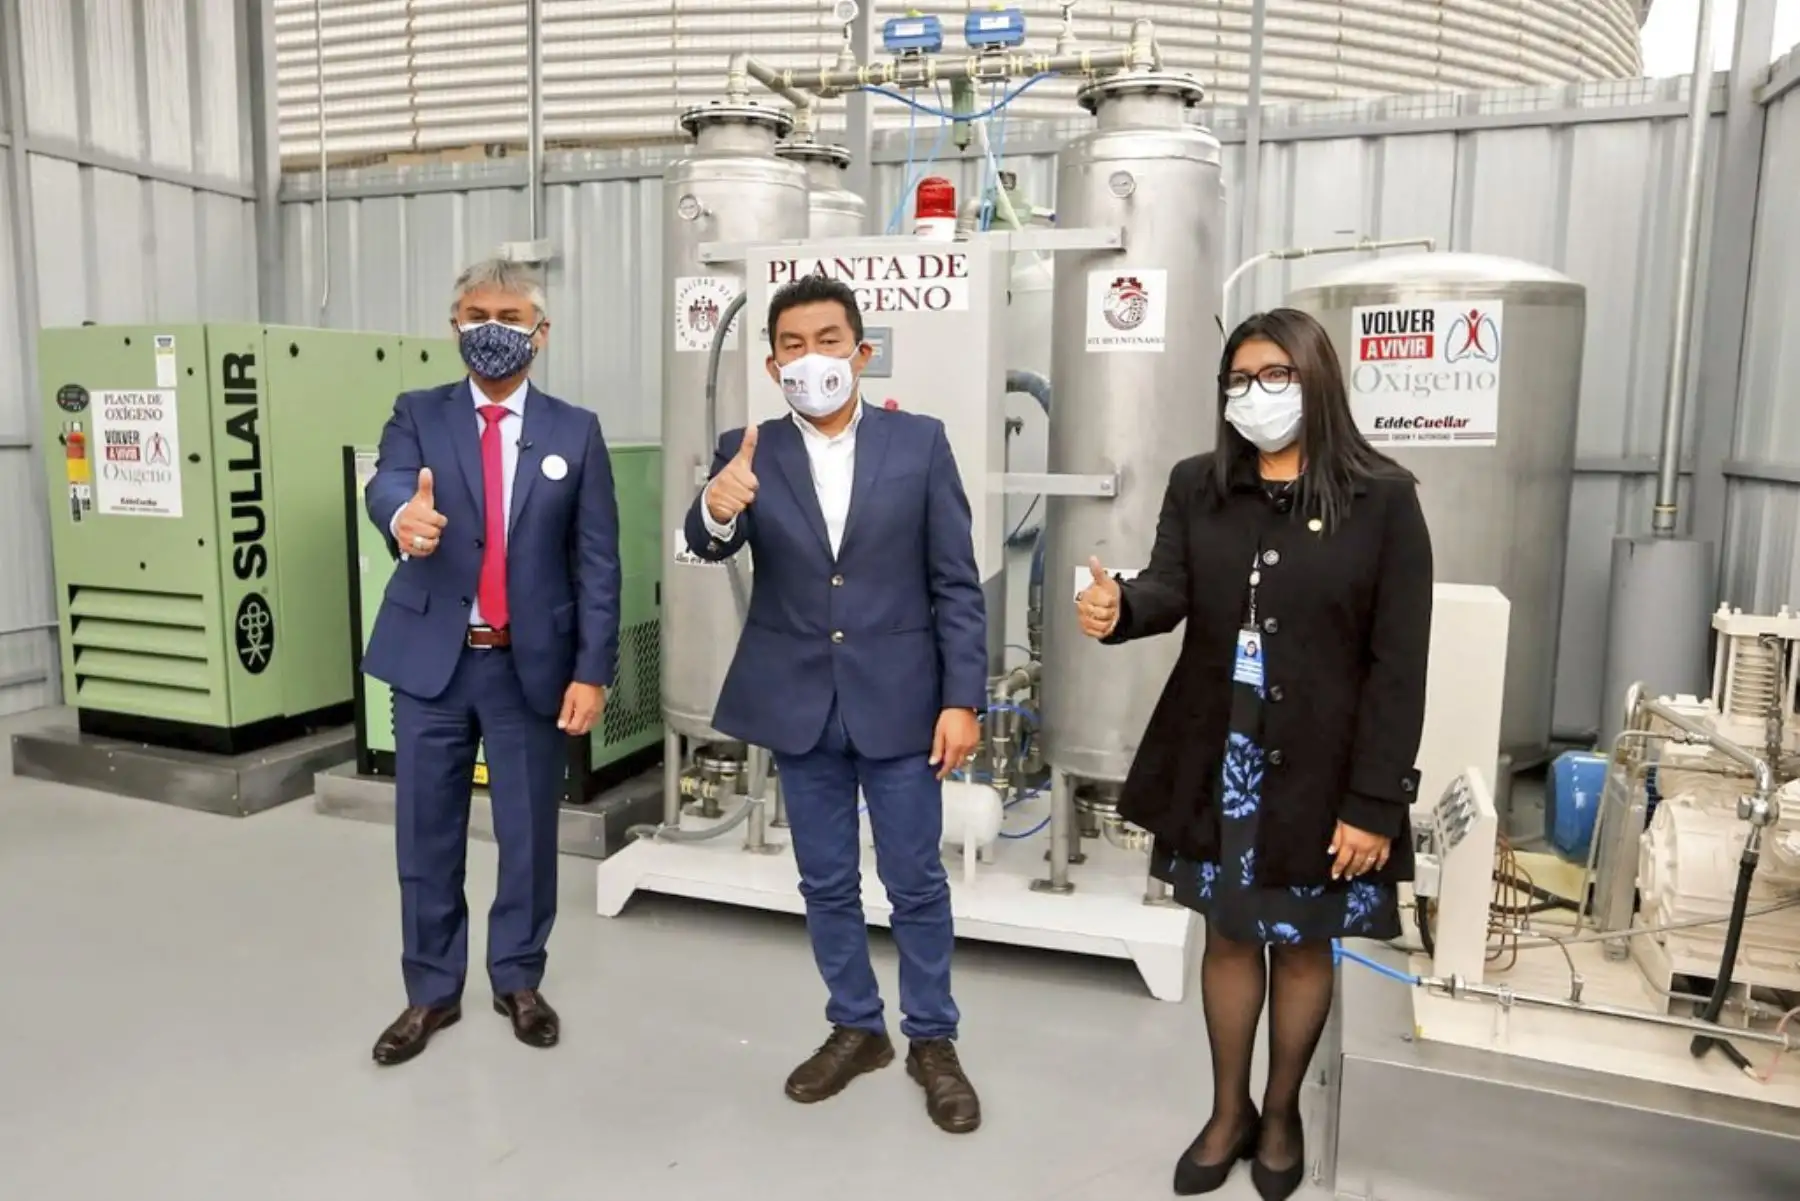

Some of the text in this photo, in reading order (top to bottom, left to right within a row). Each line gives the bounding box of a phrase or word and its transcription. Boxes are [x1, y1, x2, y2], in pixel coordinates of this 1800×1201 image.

[768, 253, 969, 283] PLANTA DE
[853, 286, 952, 311] GENO
[1361, 309, 1435, 335] VOLVER
[1366, 338, 1428, 359] A VIVIR
[104, 393, 163, 406] PLANTA DE
[1374, 415, 1471, 430] EddeCuellar
[104, 429, 140, 445] VOLVER
[223, 352, 268, 580] SULLAIR
